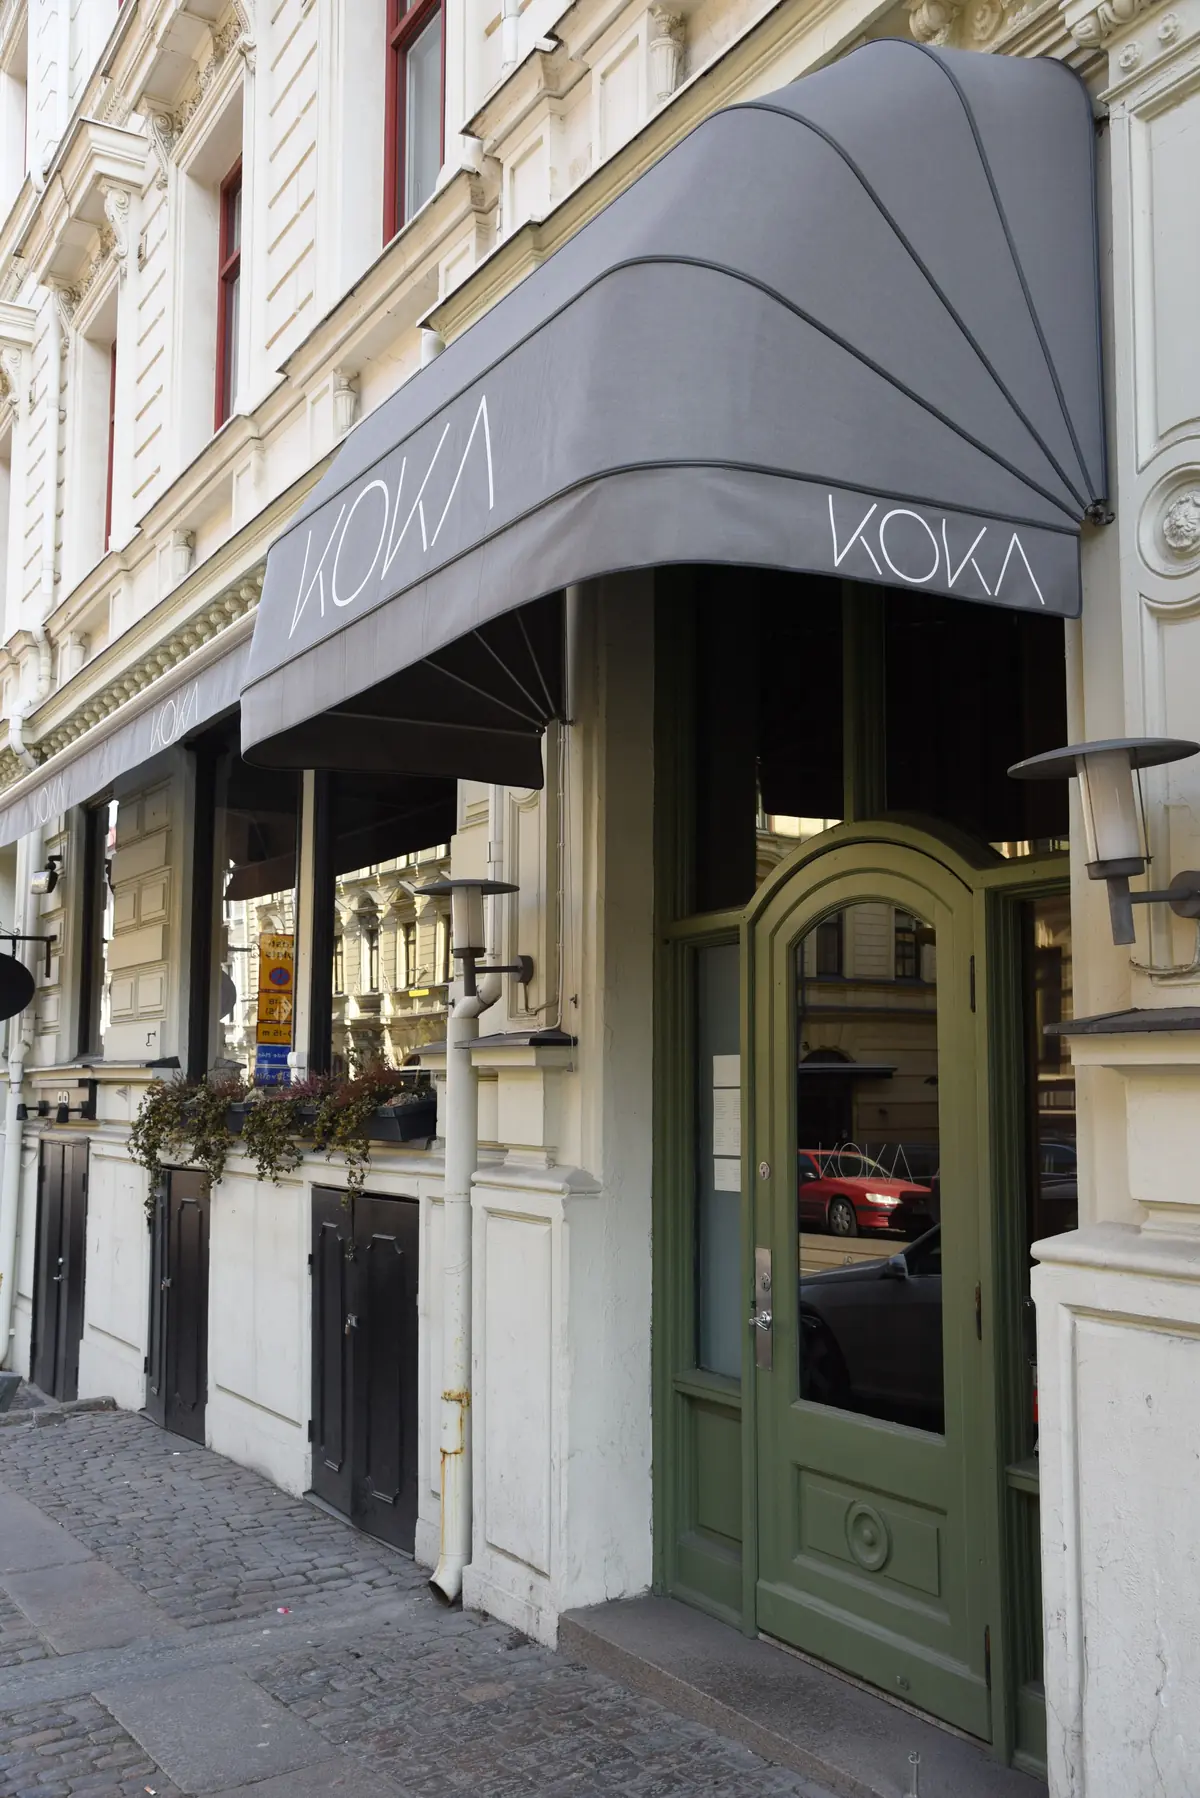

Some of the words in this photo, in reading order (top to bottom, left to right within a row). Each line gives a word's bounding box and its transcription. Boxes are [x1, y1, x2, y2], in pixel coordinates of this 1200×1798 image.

[289, 395, 494, 640] KOKA
[828, 494, 1045, 605] KOKA
[149, 681, 199, 753] KOKA
[818, 1141, 915, 1185] KOKA
